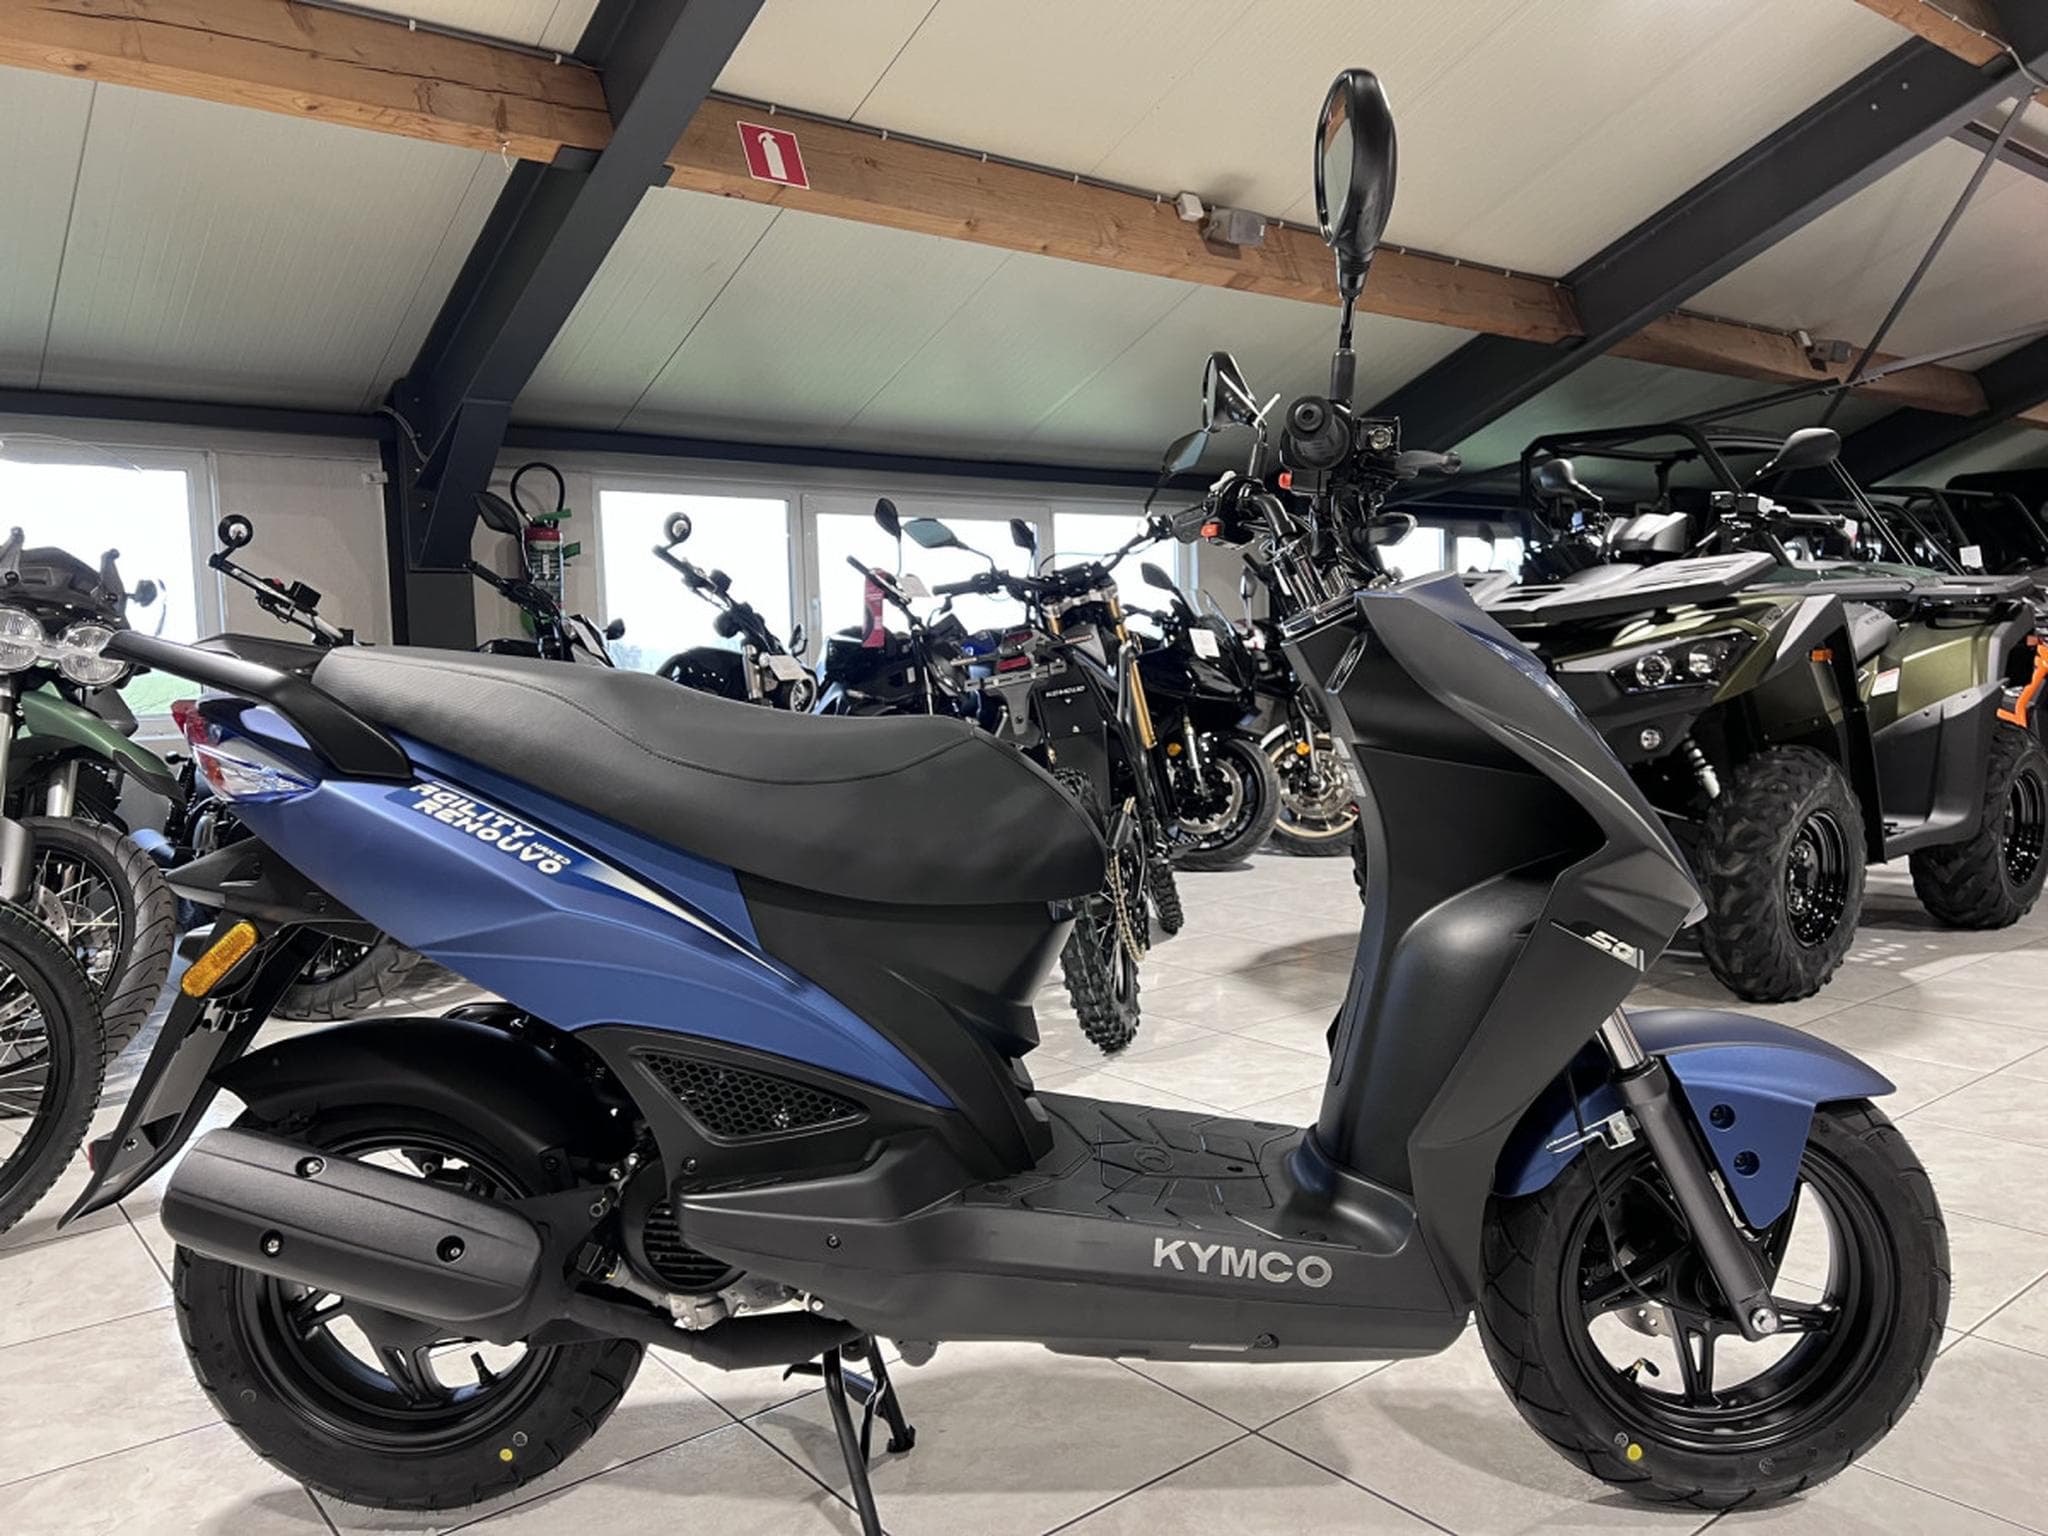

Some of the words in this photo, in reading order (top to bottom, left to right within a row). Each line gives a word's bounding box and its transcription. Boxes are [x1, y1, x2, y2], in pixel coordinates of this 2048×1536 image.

[409, 782, 535, 839] AGILITY
[412, 799, 563, 875] RENOUVO
[1153, 1237, 1333, 1288] KYMCO
